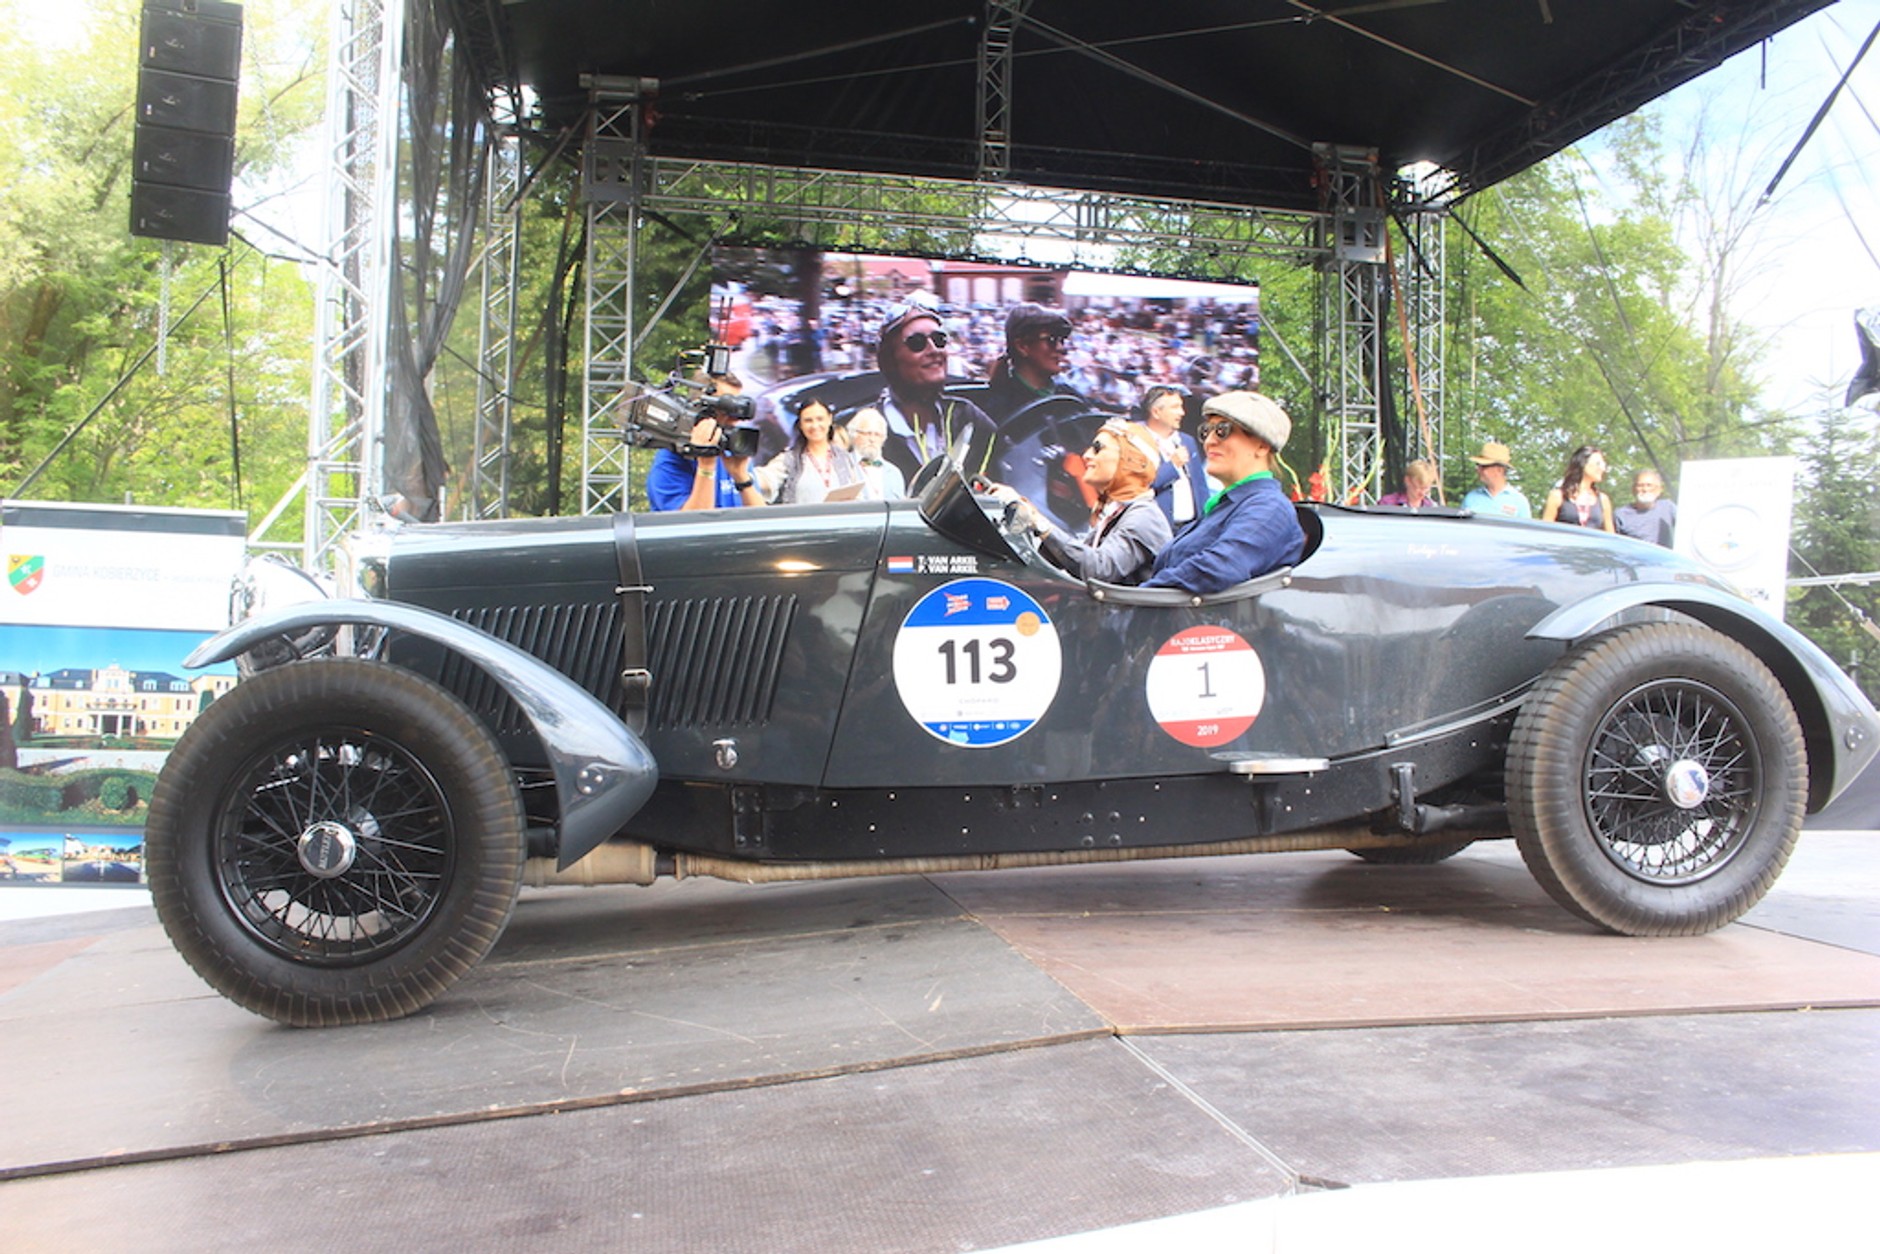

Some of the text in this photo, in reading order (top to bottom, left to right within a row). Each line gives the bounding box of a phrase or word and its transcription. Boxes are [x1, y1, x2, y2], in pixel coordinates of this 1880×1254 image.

[918, 556, 978, 565] T. VAN ARKEL
[53, 564, 89, 578] GMINA
[93, 567, 160, 582] KOBIERZYCE
[918, 565, 978, 574] P. VAN ARKEL
[938, 638, 1017, 685] 113
[1197, 661, 1216, 699] 1
[1196, 724, 1219, 737] 2019
